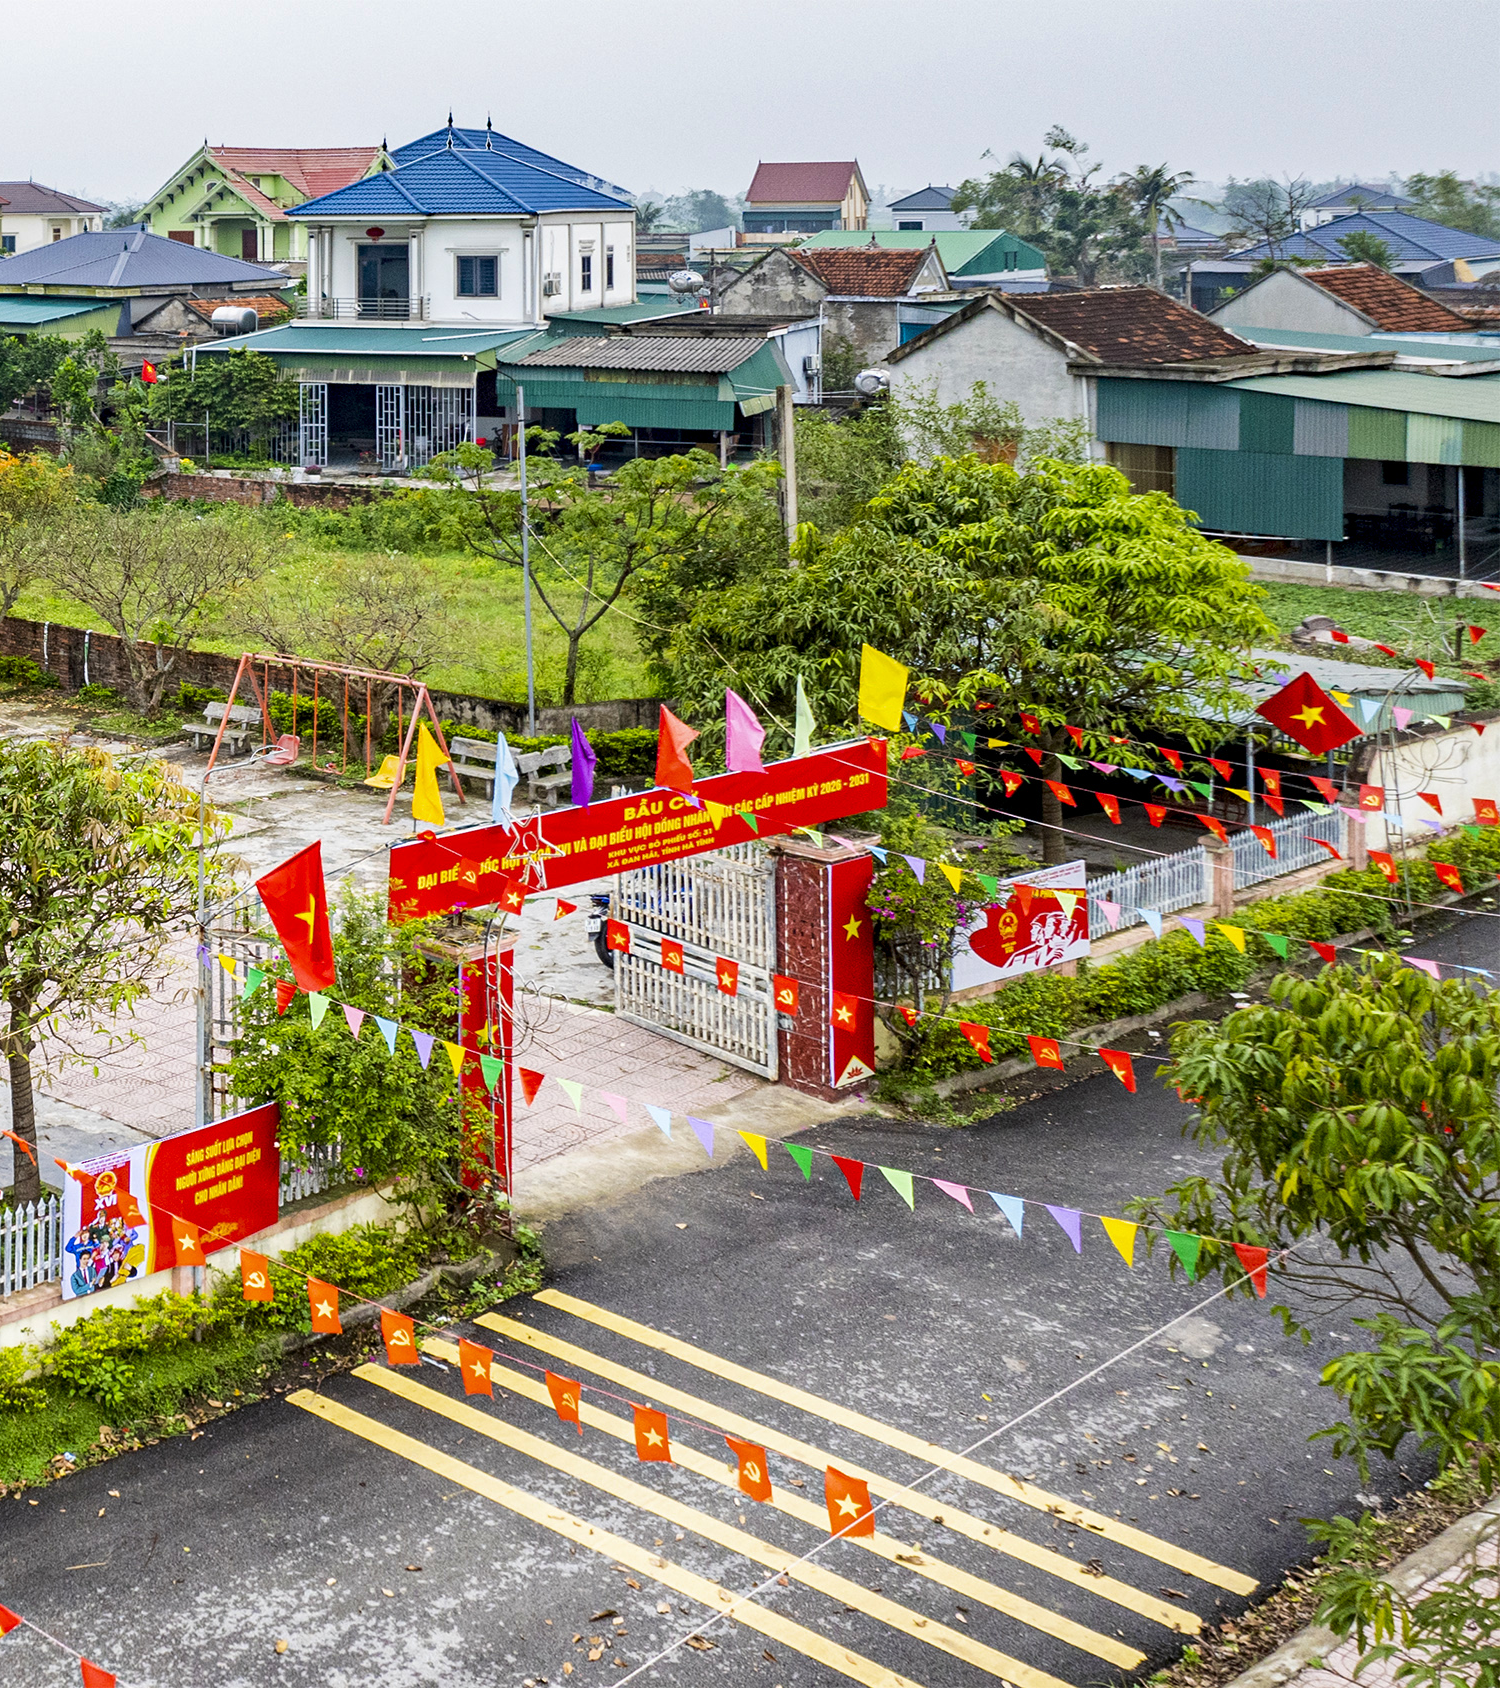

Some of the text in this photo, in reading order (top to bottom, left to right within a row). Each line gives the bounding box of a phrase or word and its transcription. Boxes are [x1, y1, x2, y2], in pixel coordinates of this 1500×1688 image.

[624, 798, 664, 821] BẦU
[417, 872, 438, 890] ĐẠI
[440, 862, 460, 884] BIỂ
[573, 836, 588, 854] VÀ
[589, 835, 608, 851] ĐẠI
[609, 825, 633, 846] BIỂU
[634, 822, 652, 840] HỘI
[653, 816, 681, 835] ĐỒNG
[682, 809, 710, 828] NHÂN
[734, 798, 753, 815] CÁC
[754, 793, 774, 810] CẤP
[775, 787, 805, 805] NHIỆM
[806, 782, 819, 798] KỲ
[820, 779, 842, 795] 2026
[848, 772, 870, 788] 2031
[607, 858, 620, 869] XÃ
[621, 855, 641, 866] ĐAN
[682, 840, 695, 851] HÀ
[608, 849, 627, 859] KHU
[628, 843, 647, 854] VỰC
[662, 832, 686, 846] PHIẾU
[185, 1130, 253, 1167] SÁNG SUỐT LỰA CHỌN
[175, 1147, 262, 1191] NGƯỜI XỨNG ĐÁNG ĐẠI DIỆN
[94, 1193, 117, 1211] XVI
[194, 1188, 208, 1206] CHO
[208, 1180, 227, 1200] NHÂN
